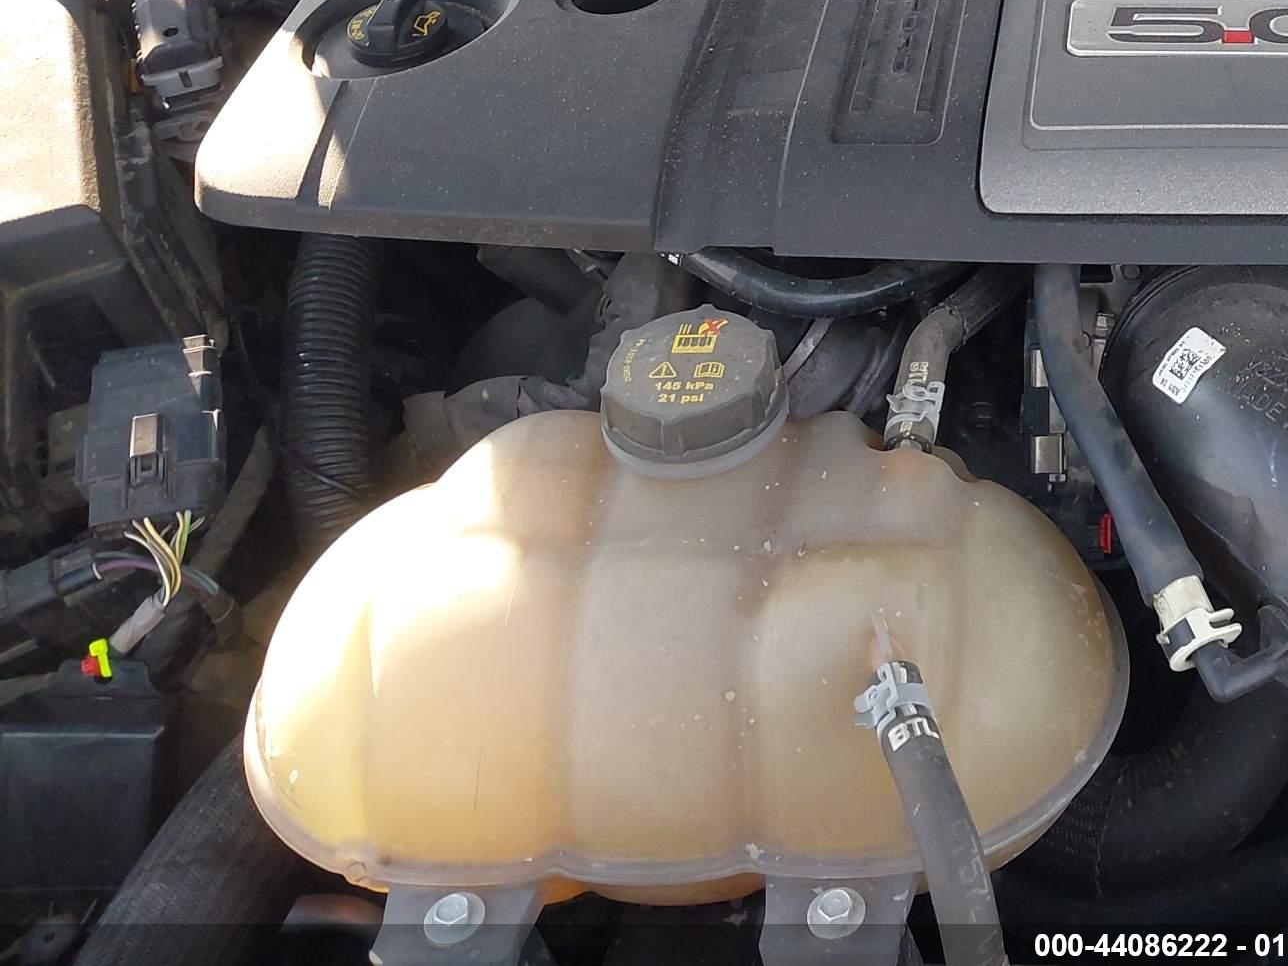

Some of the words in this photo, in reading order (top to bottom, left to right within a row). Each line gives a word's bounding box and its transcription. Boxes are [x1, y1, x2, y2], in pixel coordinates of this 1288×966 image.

[655, 381, 682, 391] 145
[685, 381, 714, 391] kPa
[657, 394, 677, 403] 21
[680, 393, 705, 404] psi
[887, 717, 940, 752] BTL
